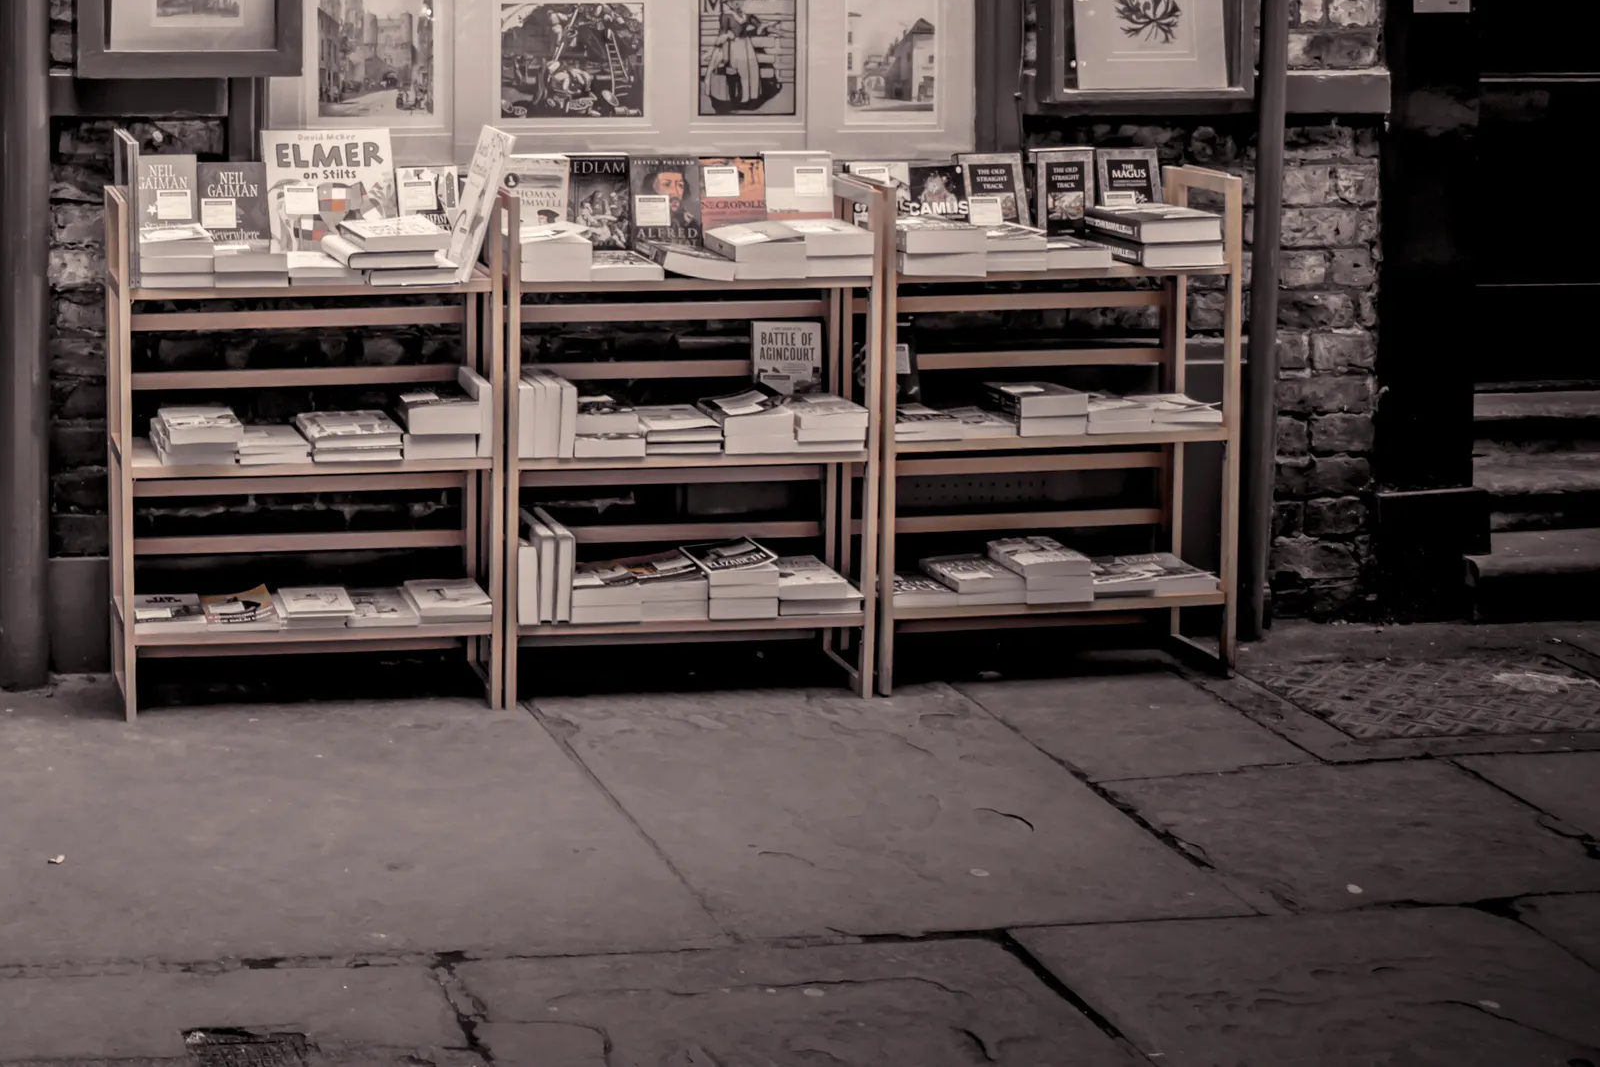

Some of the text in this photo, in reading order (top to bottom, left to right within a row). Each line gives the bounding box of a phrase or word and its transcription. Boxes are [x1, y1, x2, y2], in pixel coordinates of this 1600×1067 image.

[297, 132, 356, 142] David McKee
[275, 141, 384, 169] ELMER
[149, 164, 176, 177] NEIL
[1112, 169, 1147, 178] MAGUS
[1121, 163, 1135, 171] THE
[219, 172, 246, 185] NEIL
[303, 170, 357, 180] on Stilts
[1051, 173, 1080, 182] STRAIGHT
[138, 176, 188, 190] GAIMAN
[207, 184, 258, 198] GAIMAN
[517, 190, 557, 199] HOMAS
[701, 199, 767, 210] NECROPOLIS
[909, 200, 969, 216] CAMUS
[210, 228, 260, 241] Neverwhere
[637, 227, 699, 239] ALFRED
[761, 332, 813, 346] BATTLE OF
[759, 347, 815, 361] AGINCOURT
[706, 551, 767, 569] ELIZABETH
